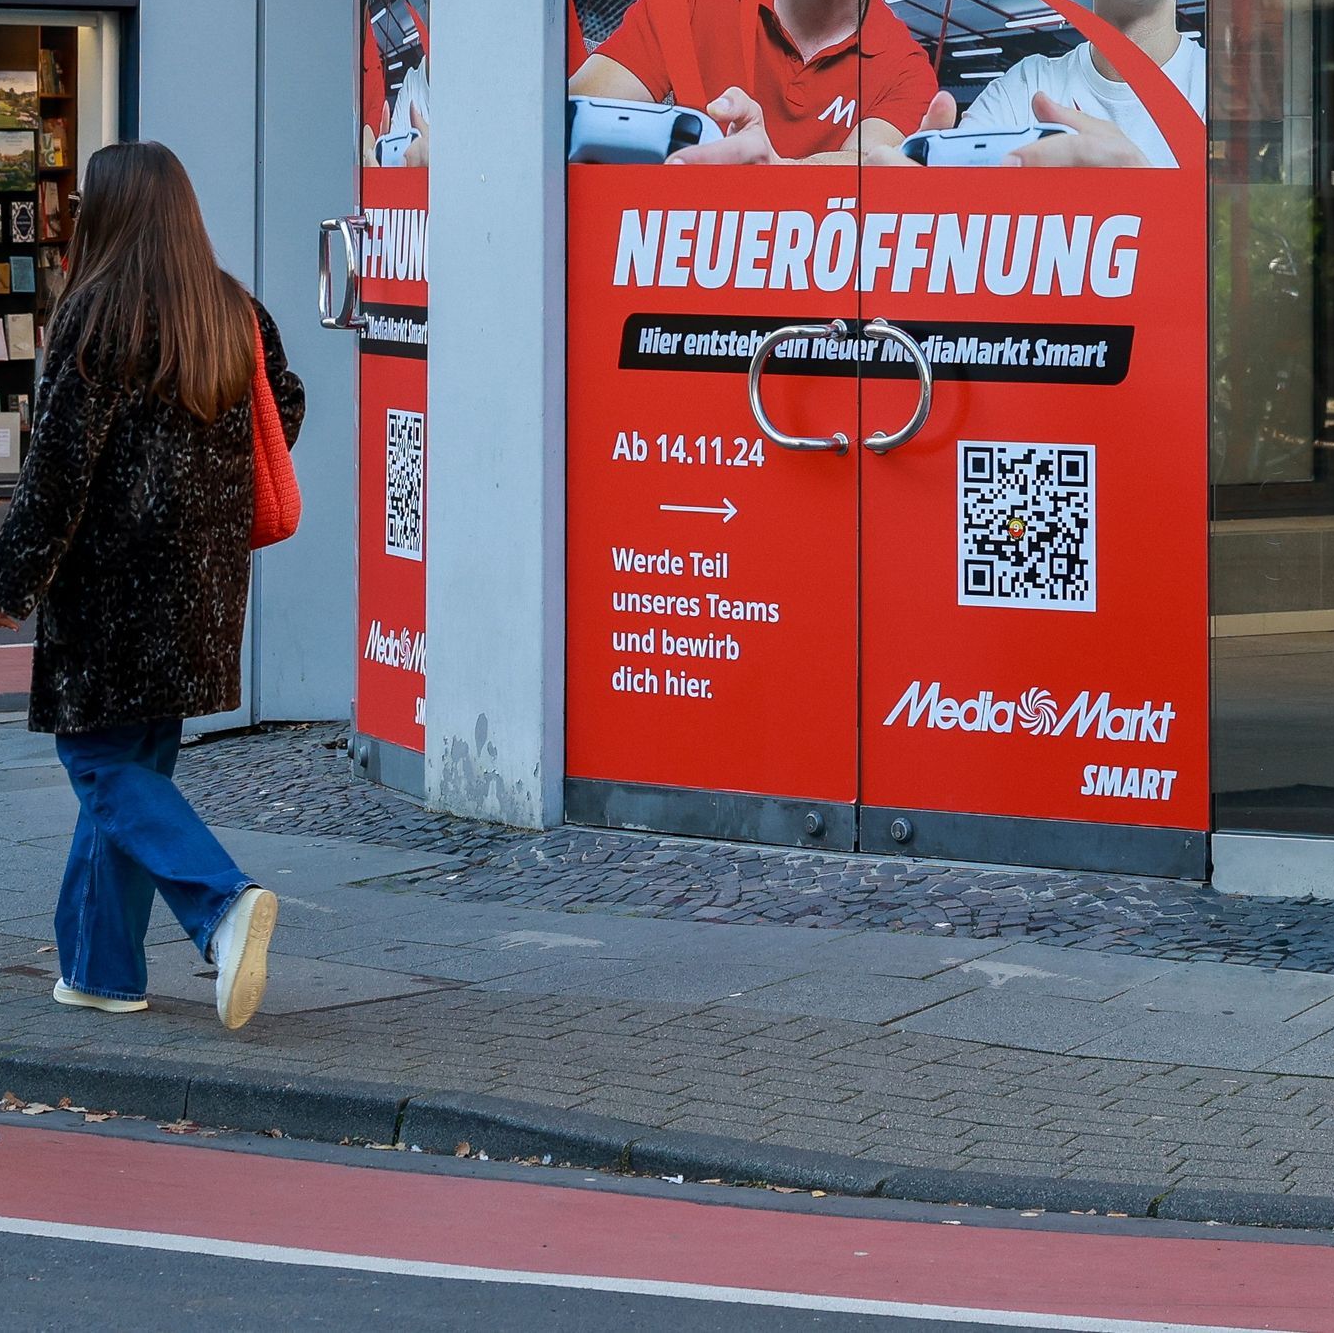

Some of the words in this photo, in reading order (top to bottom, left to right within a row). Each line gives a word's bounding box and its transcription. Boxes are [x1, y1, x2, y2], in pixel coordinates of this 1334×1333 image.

[613, 197, 1142, 298] NEUERÖFFNUNG
[638, 327, 682, 355] Hier
[683, 330, 771, 357] entsteh
[1032, 339, 1109, 368] Smart
[612, 431, 648, 462] Ab
[656, 434, 765, 467] 14.11.24
[612, 547, 684, 576] Werde
[689, 552, 728, 578] Teil
[612, 592, 700, 617] unseres
[706, 594, 779, 623] Teams
[612, 628, 655, 654] und
[661, 629, 740, 660] bewirb
[612, 666, 658, 695] dich
[665, 669, 713, 699] hier.
[883, 681, 1017, 734] Media
[1050, 690, 1176, 743] Markt
[1080, 764, 1178, 801] SMART
